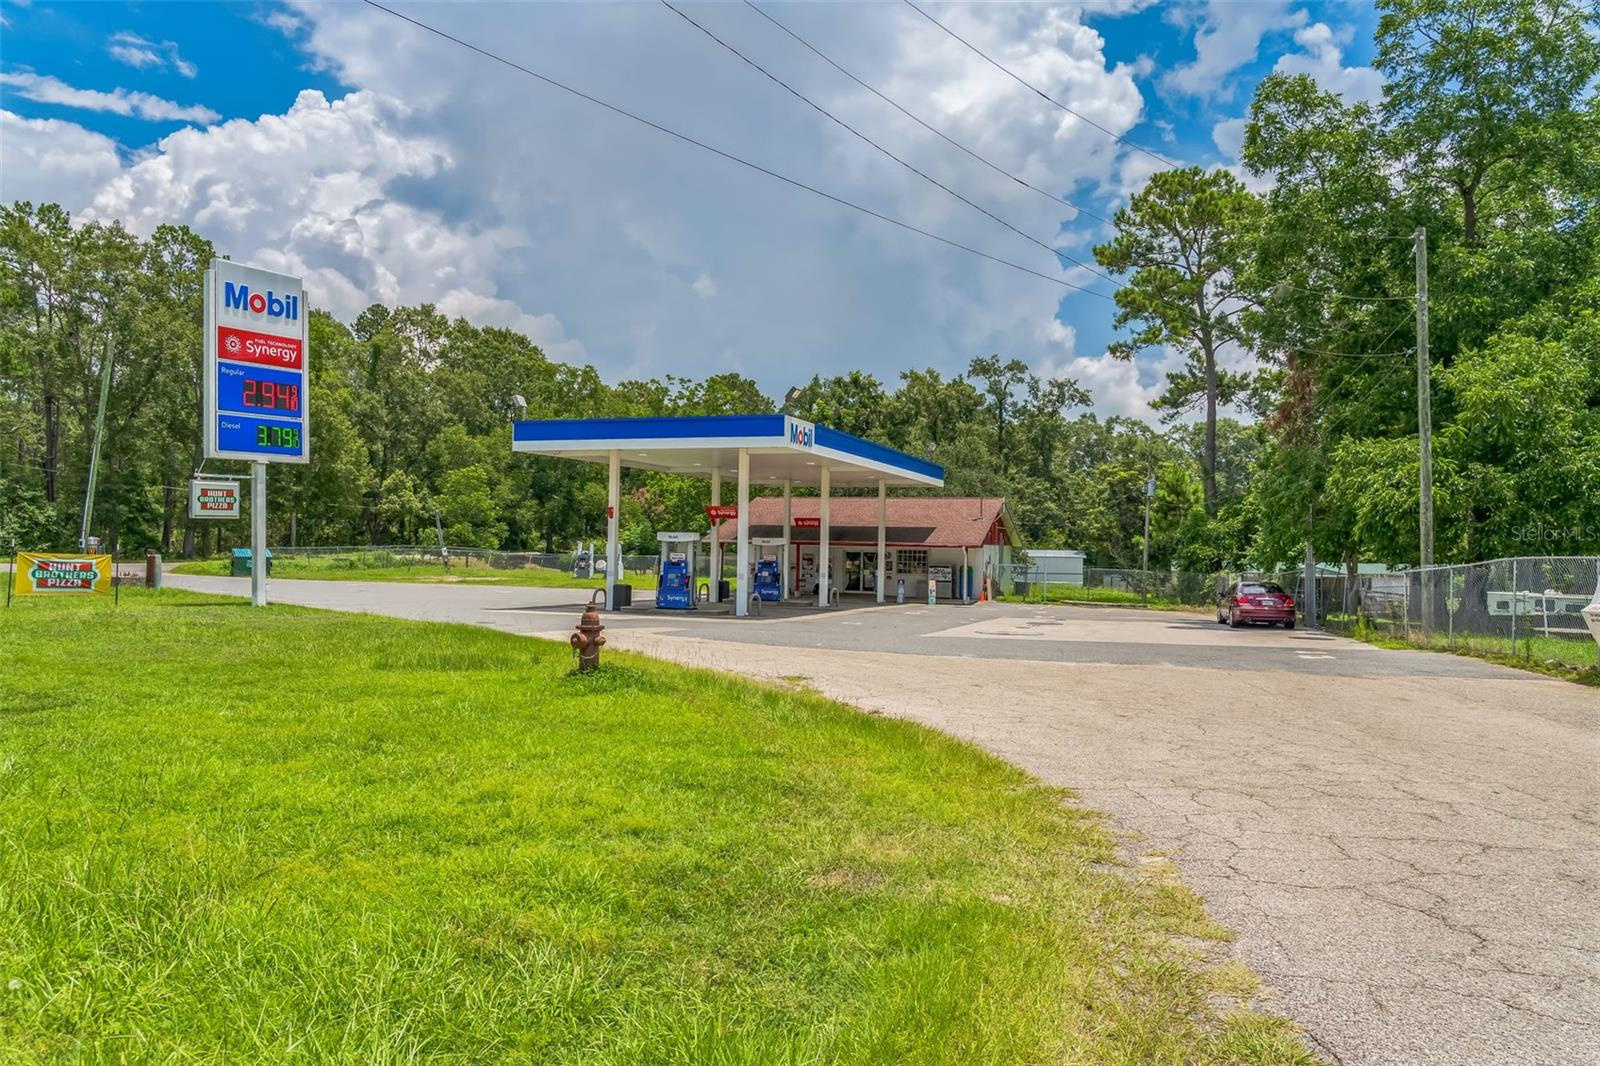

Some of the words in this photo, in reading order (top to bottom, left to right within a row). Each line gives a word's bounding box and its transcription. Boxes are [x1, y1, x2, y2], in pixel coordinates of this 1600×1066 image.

[225, 281, 298, 320] Mobil
[246, 340, 297, 362] Synergy
[221, 366, 245, 376] Regular
[243, 379, 290, 410] 2.94
[221, 421, 241, 430] Diesel
[257, 425, 292, 448] 3.79
[791, 422, 813, 448] Mobil
[48, 562, 81, 571] HUNT
[35, 570, 94, 580] BROTHERS
[47, 578, 82, 587] PIZZA
